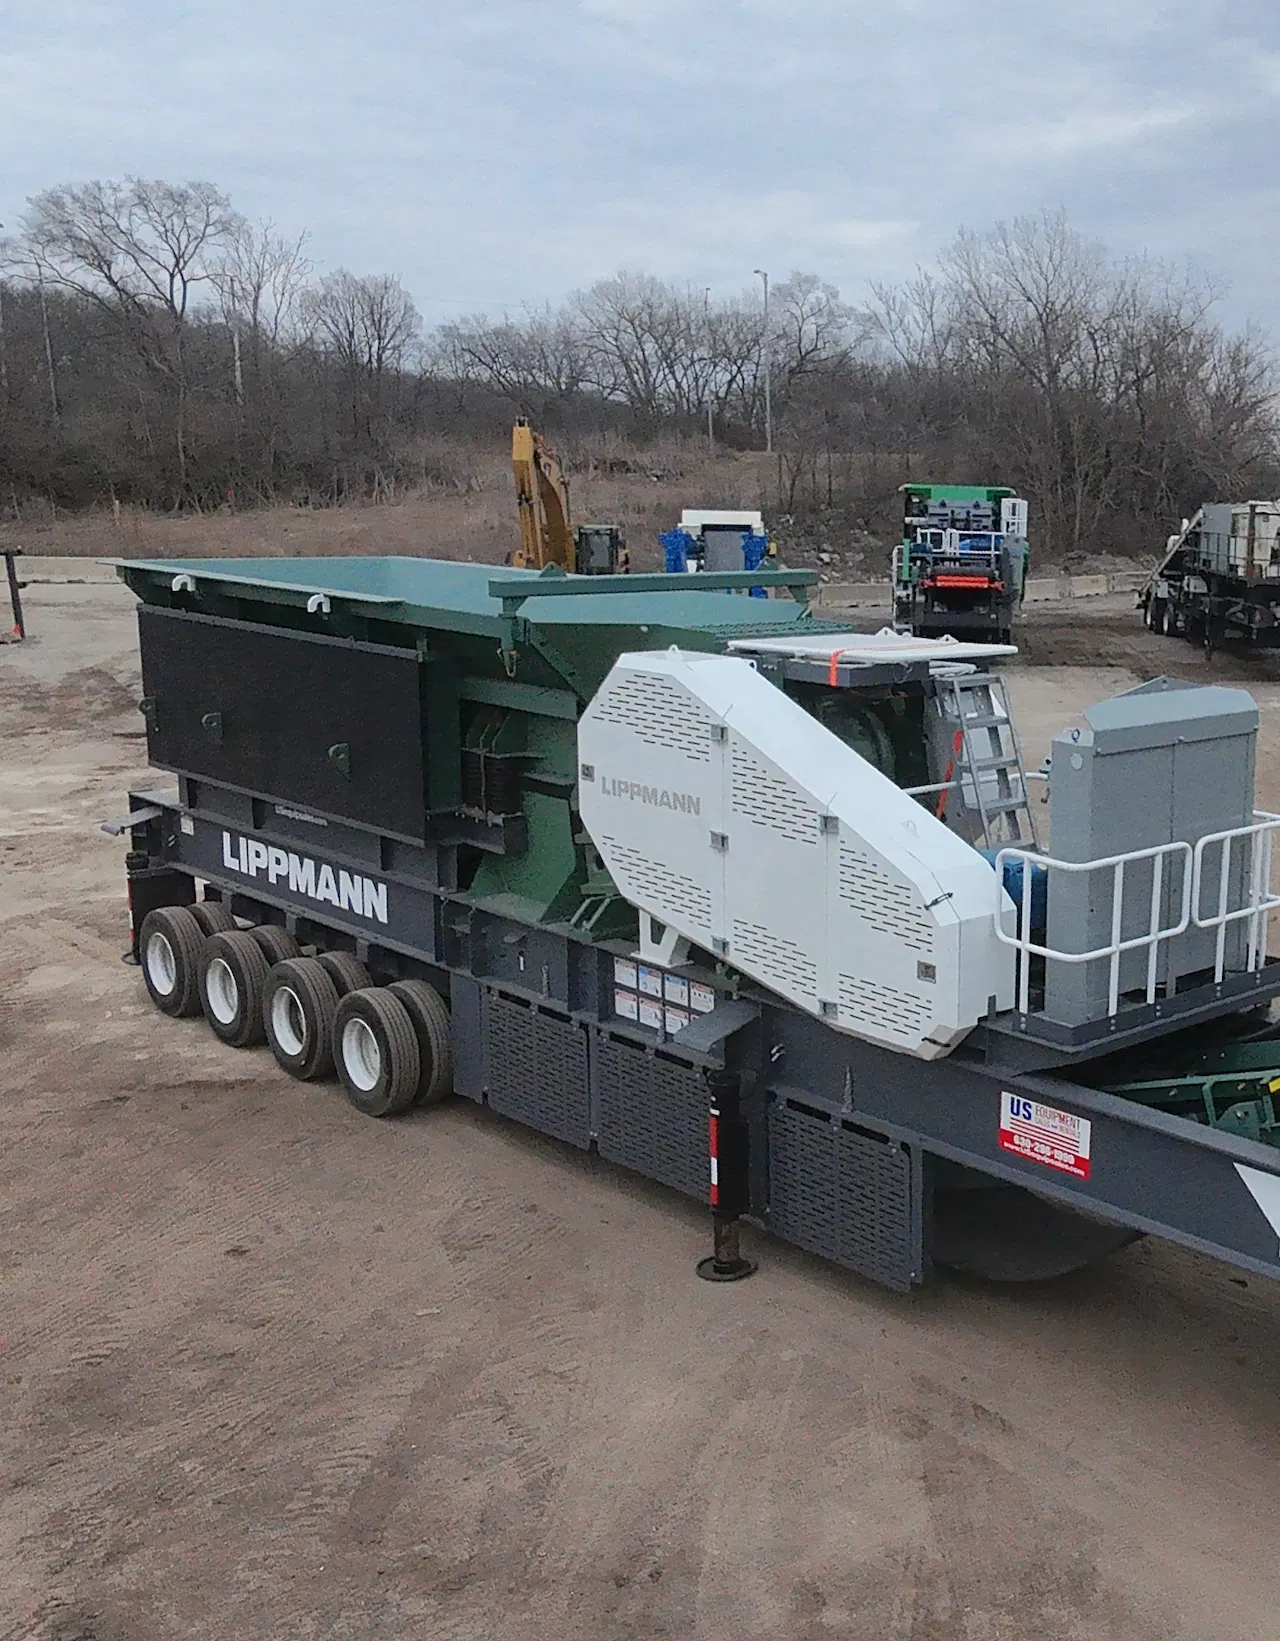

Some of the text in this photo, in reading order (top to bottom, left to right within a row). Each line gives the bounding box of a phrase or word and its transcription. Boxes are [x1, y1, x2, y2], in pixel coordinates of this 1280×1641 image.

[601, 776, 701, 817] LIPPMANN
[222, 831, 389, 924] LIPPMANN
[1010, 1096, 1032, 1121] US
[1035, 1105, 1081, 1131] EQUIPMENT
